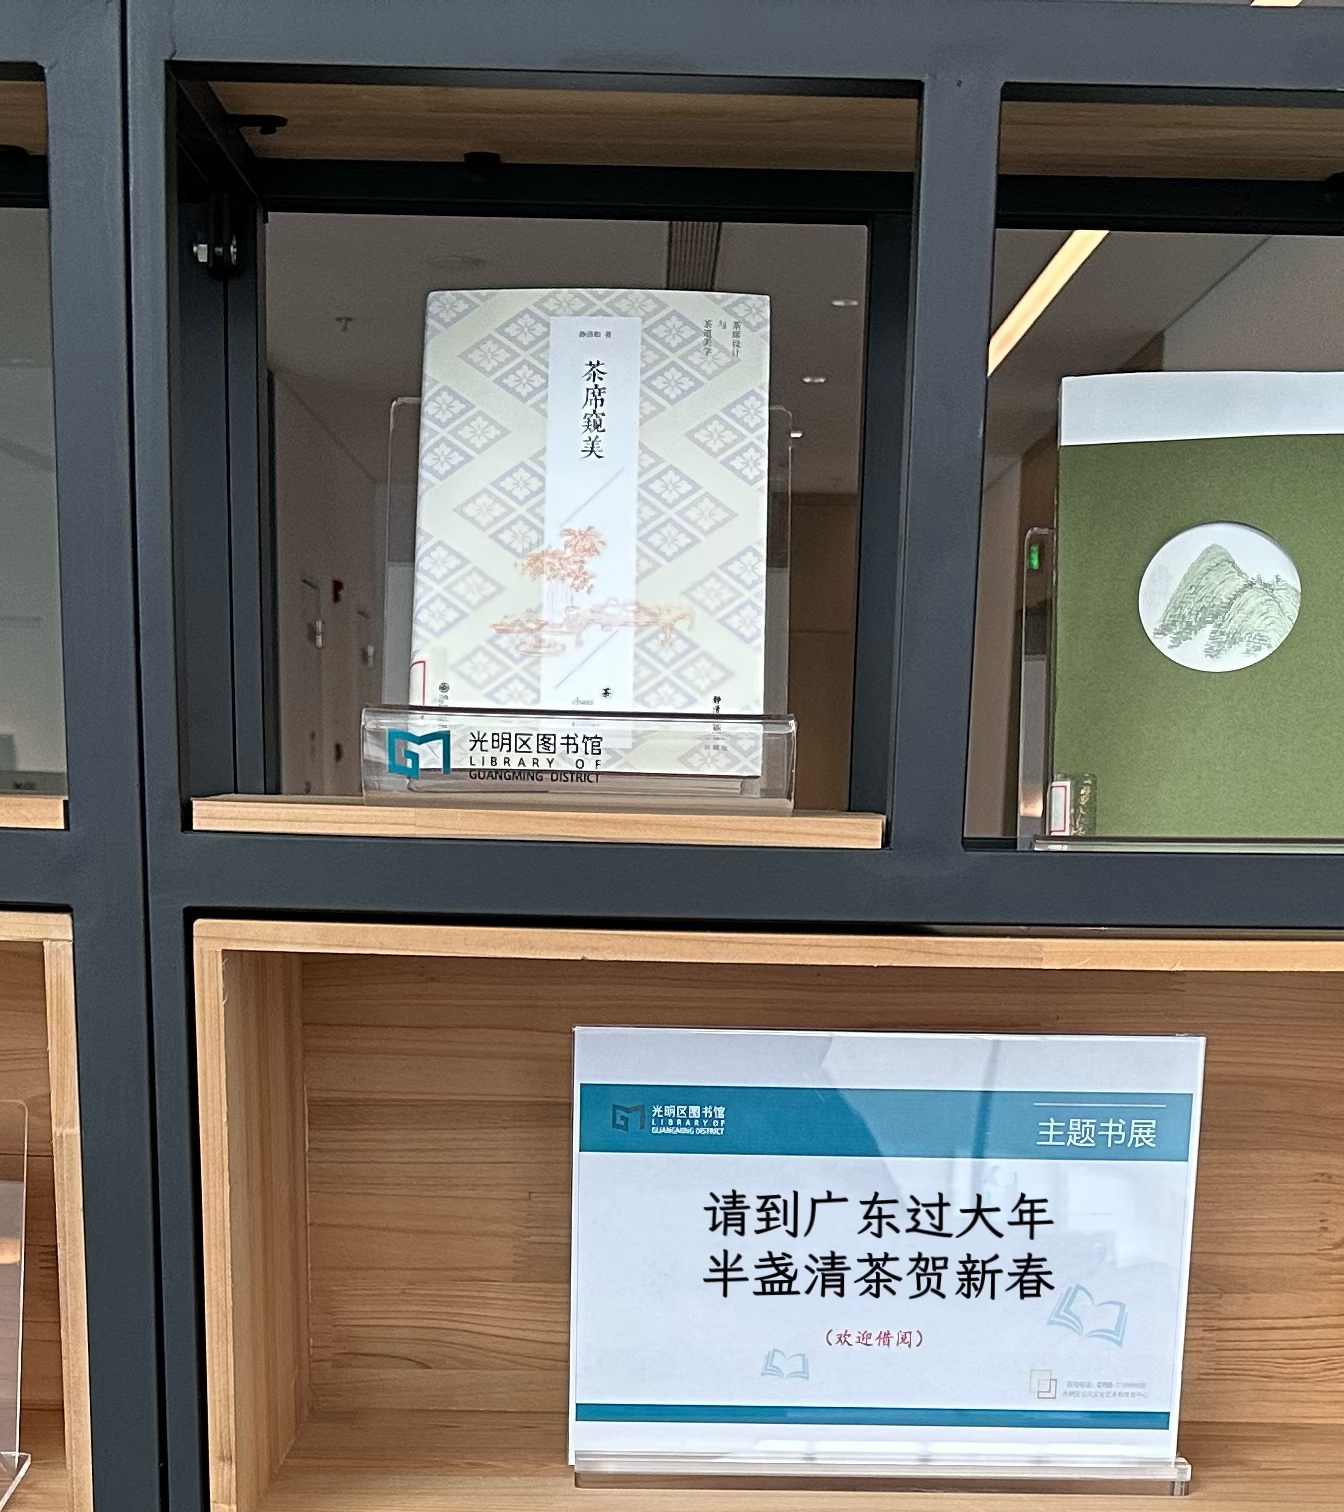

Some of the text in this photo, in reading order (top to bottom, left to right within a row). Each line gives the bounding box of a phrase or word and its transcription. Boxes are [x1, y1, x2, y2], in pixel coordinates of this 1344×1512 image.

[580, 359, 608, 460] 茶席窥美
[469, 731, 603, 756] 光明区图书馆
[468, 769, 600, 784] GUANGMING DISTRICT
[469, 756, 601, 770] LIBRARY OF
[1036, 1118, 1158, 1149] 主题书展
[703, 1190, 1055, 1241] 请到广东过大年
[702, 1249, 1056, 1300] 半盏清茶贺新春
